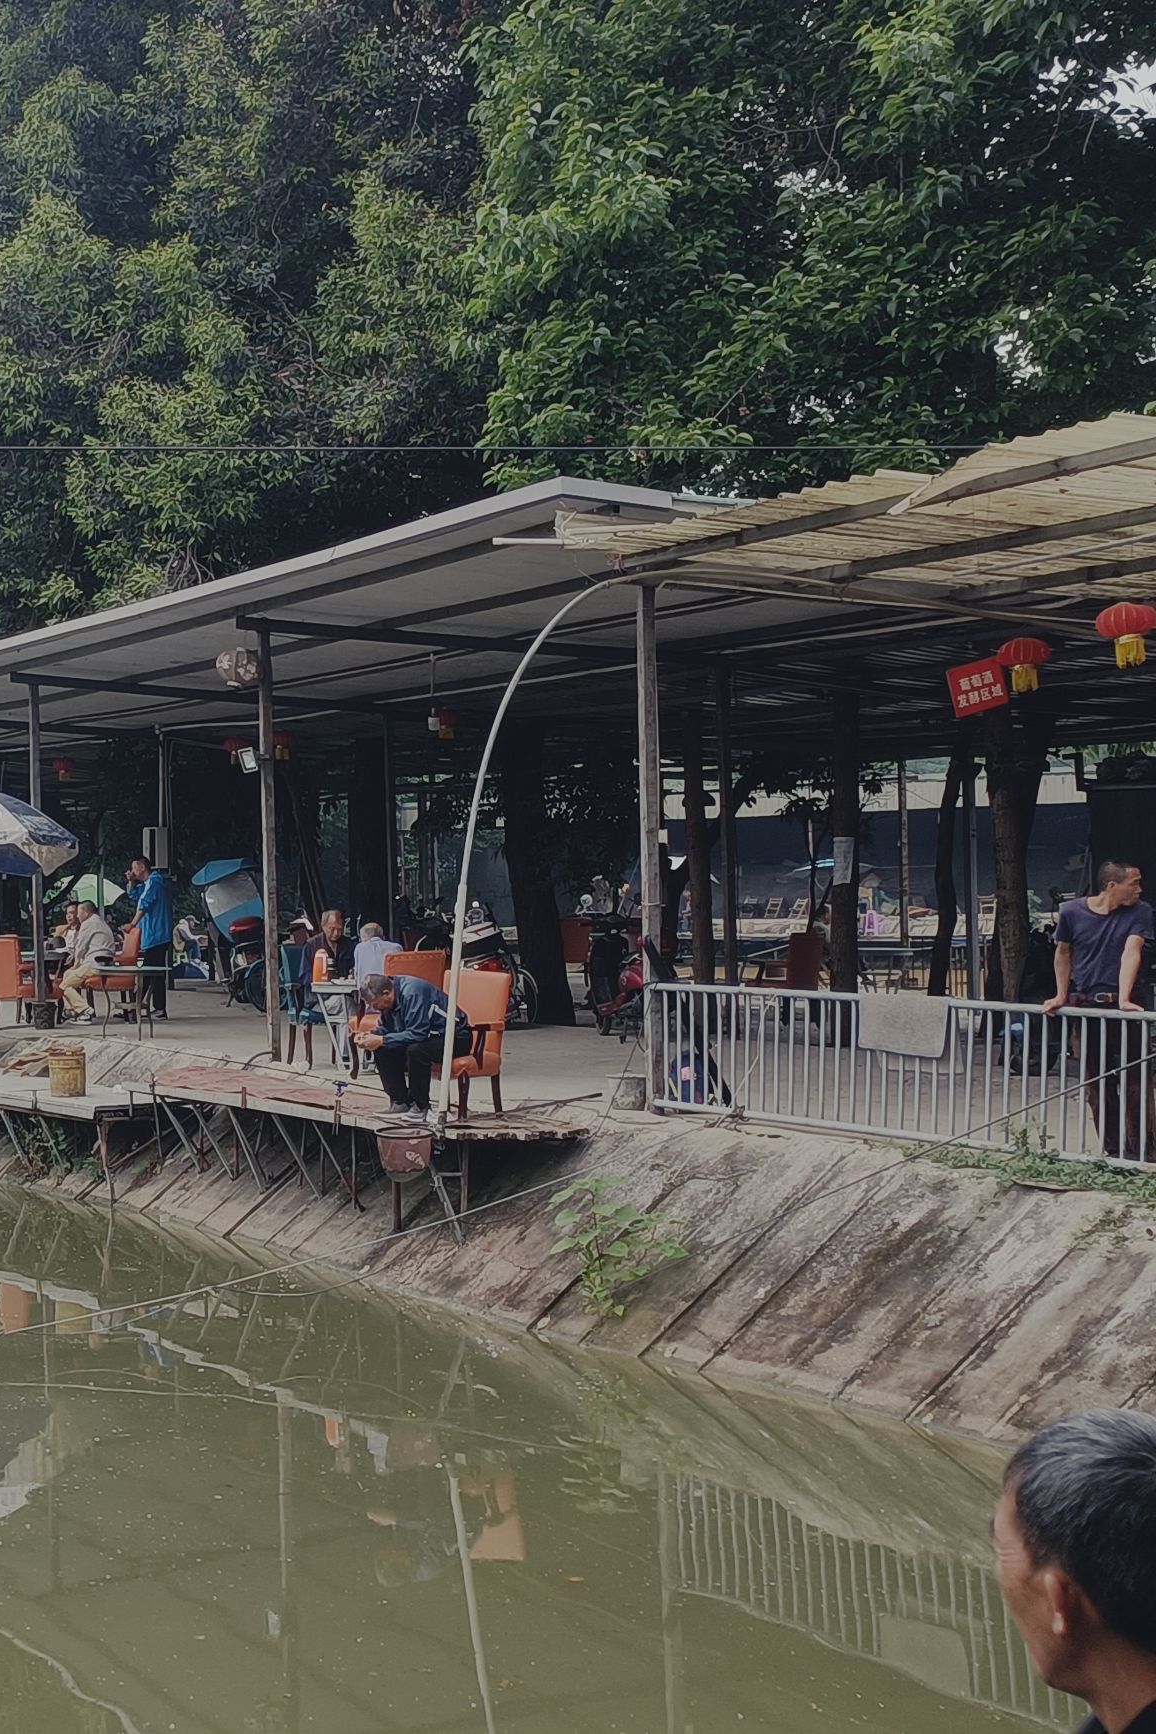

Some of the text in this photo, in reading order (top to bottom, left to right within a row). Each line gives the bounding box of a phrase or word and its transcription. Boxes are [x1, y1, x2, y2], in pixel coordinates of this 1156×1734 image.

[958, 670, 994, 691] 葡萄酒
[957, 683, 1004, 708] 发酵区域
